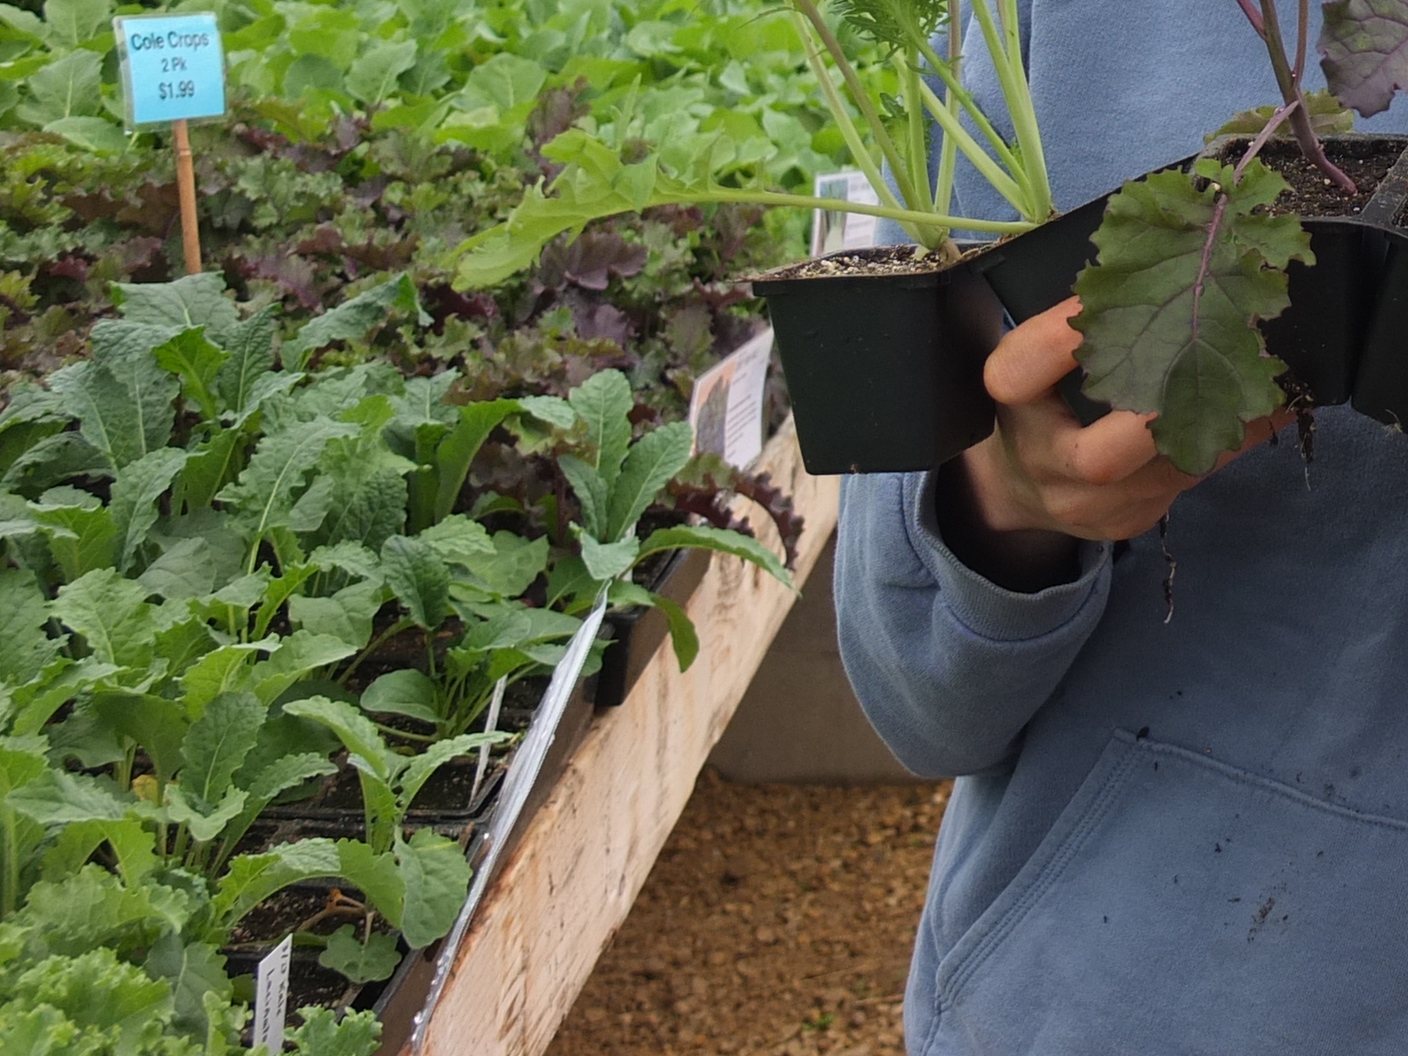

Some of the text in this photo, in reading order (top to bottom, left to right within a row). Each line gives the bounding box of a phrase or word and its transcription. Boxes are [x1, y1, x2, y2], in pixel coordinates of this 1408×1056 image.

[131, 31, 209, 52] Cole Crops
[161, 57, 187, 72] 2 Pk
[158, 80, 195, 100] $1.99
